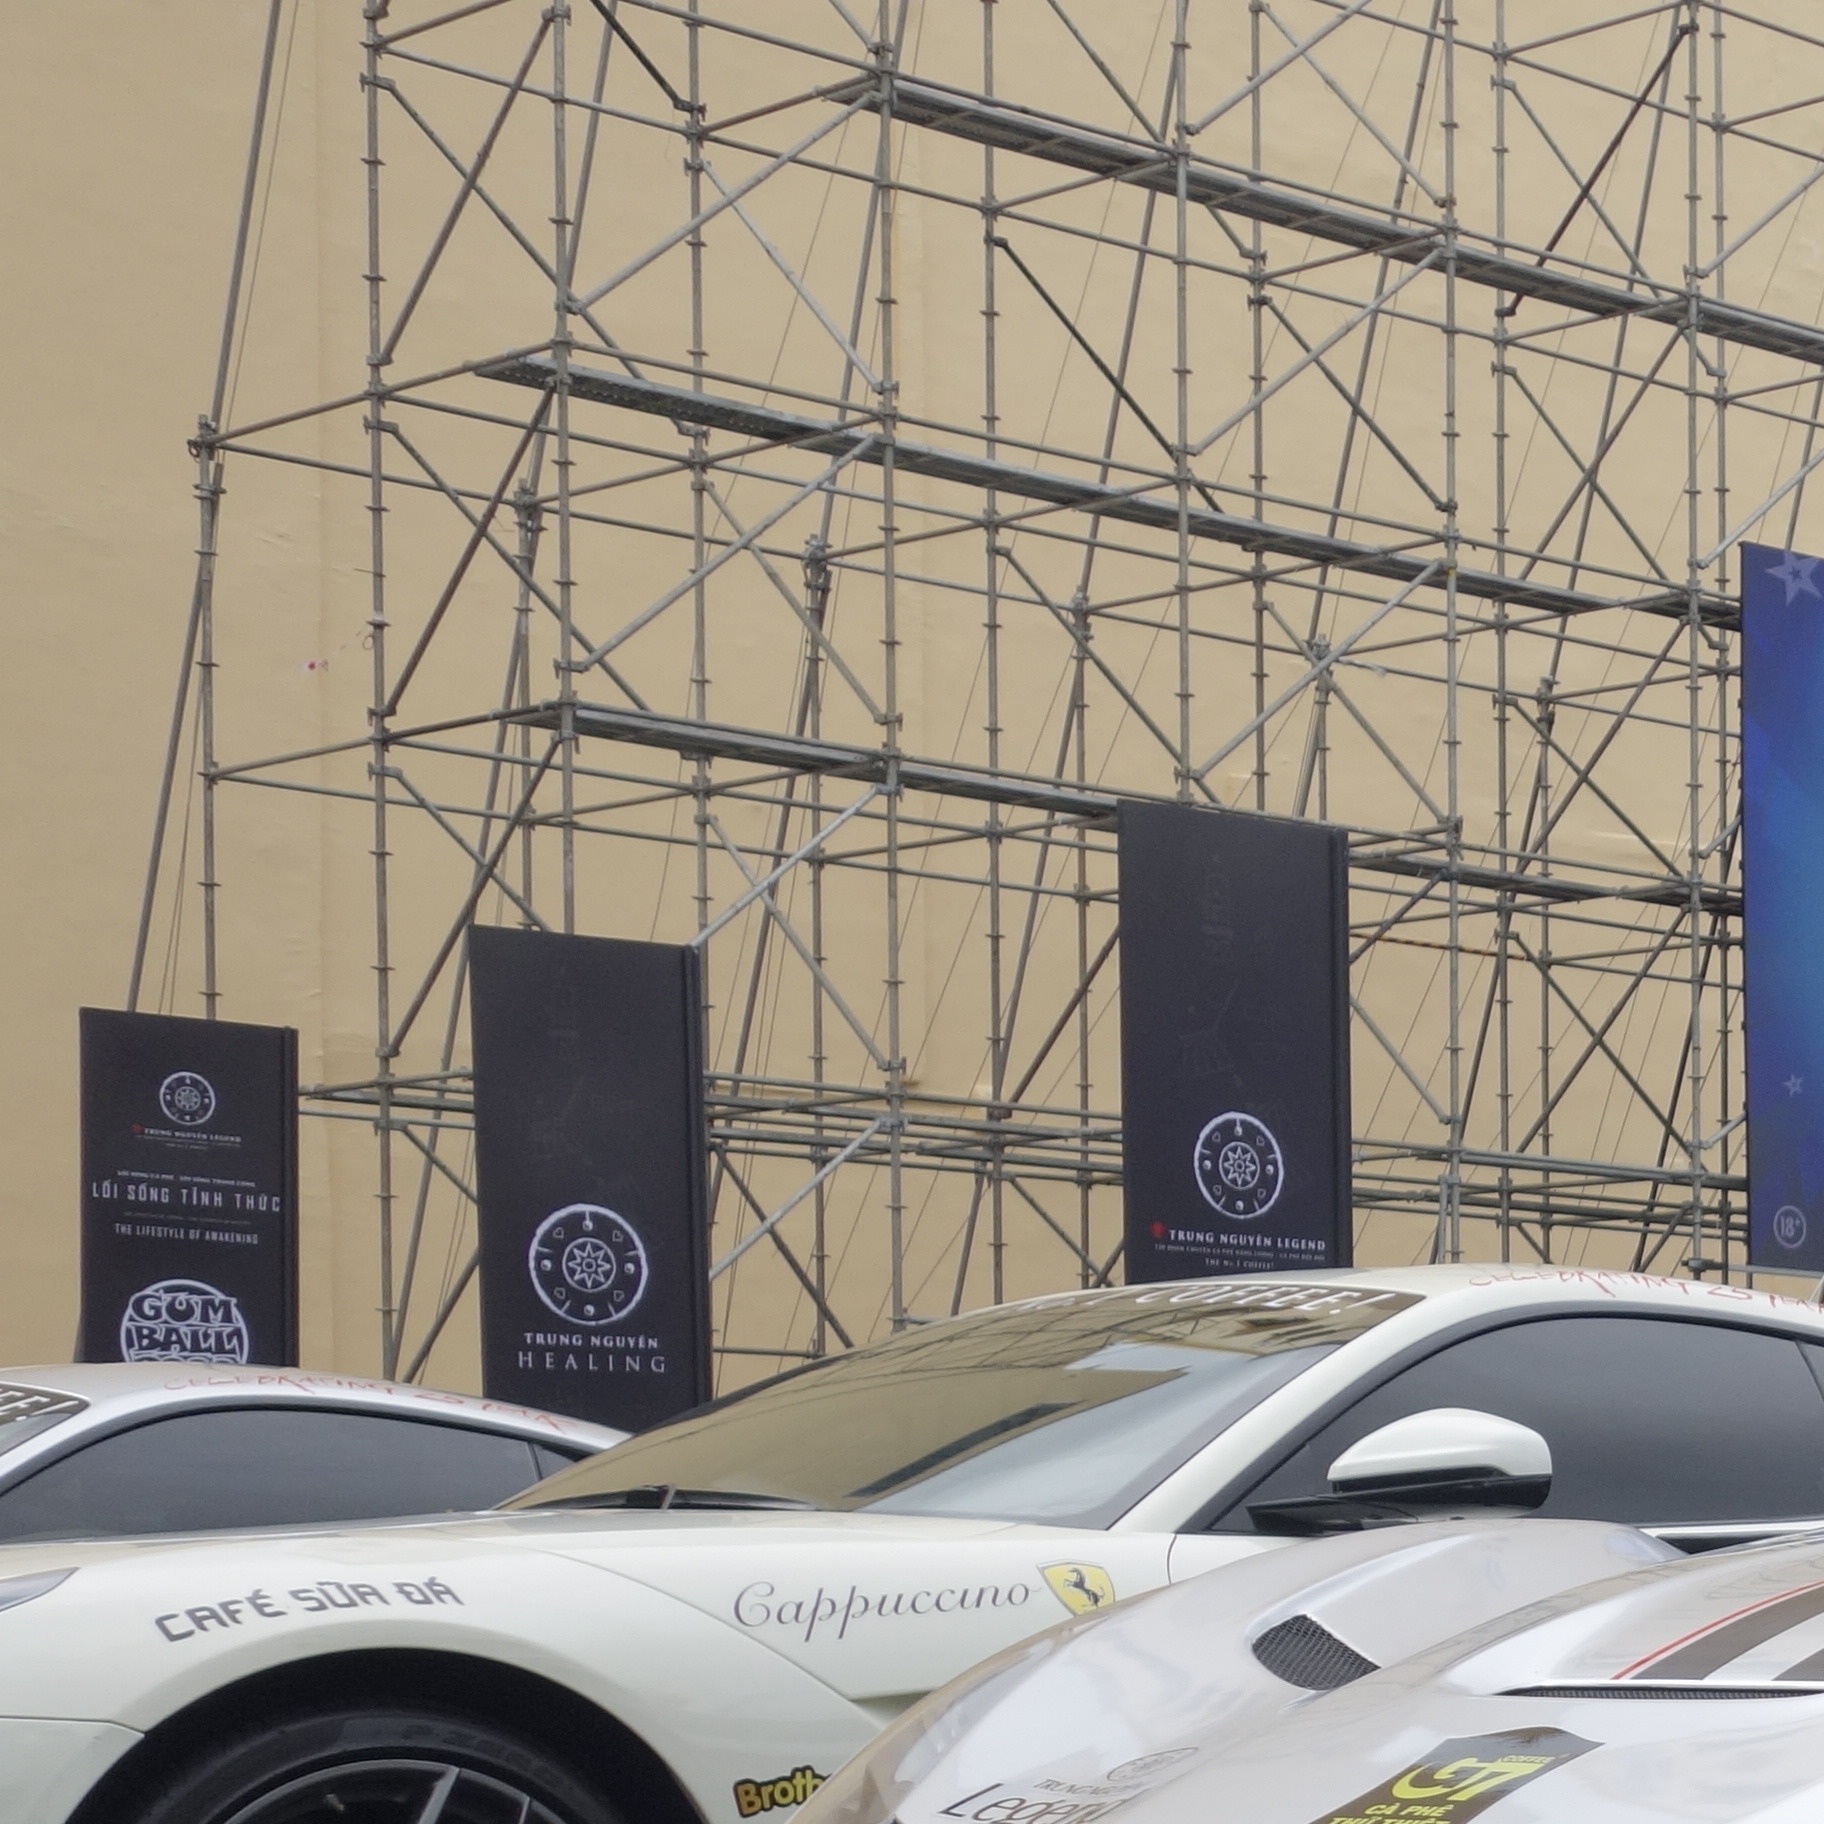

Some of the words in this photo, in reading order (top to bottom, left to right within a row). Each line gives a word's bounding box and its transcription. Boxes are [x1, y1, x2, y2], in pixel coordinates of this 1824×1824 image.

[115, 1223, 132, 1235] THE
[136, 1225, 185, 1240] LIFESTYLE
[189, 1229, 201, 1240] OF
[205, 1230, 259, 1245] AWAKENING
[1169, 1229, 1214, 1243] TRUNG
[1277, 1237, 1326, 1251] LEGEND
[129, 1288, 240, 1324] GUM
[126, 1324, 246, 1355] BALL
[524, 1332, 583, 1346] TRUNG
[518, 1351, 666, 1373] HEALING
[155, 1589, 288, 1642] CAFÉ
[392, 1576, 465, 1606] ĐÁ
[733, 1581, 1042, 1642] Cappuccino
[1391, 1757, 1547, 1801] G7
[1364, 1802, 1400, 1816] CÀ
[1399, 1804, 1454, 1818] PHÊ
